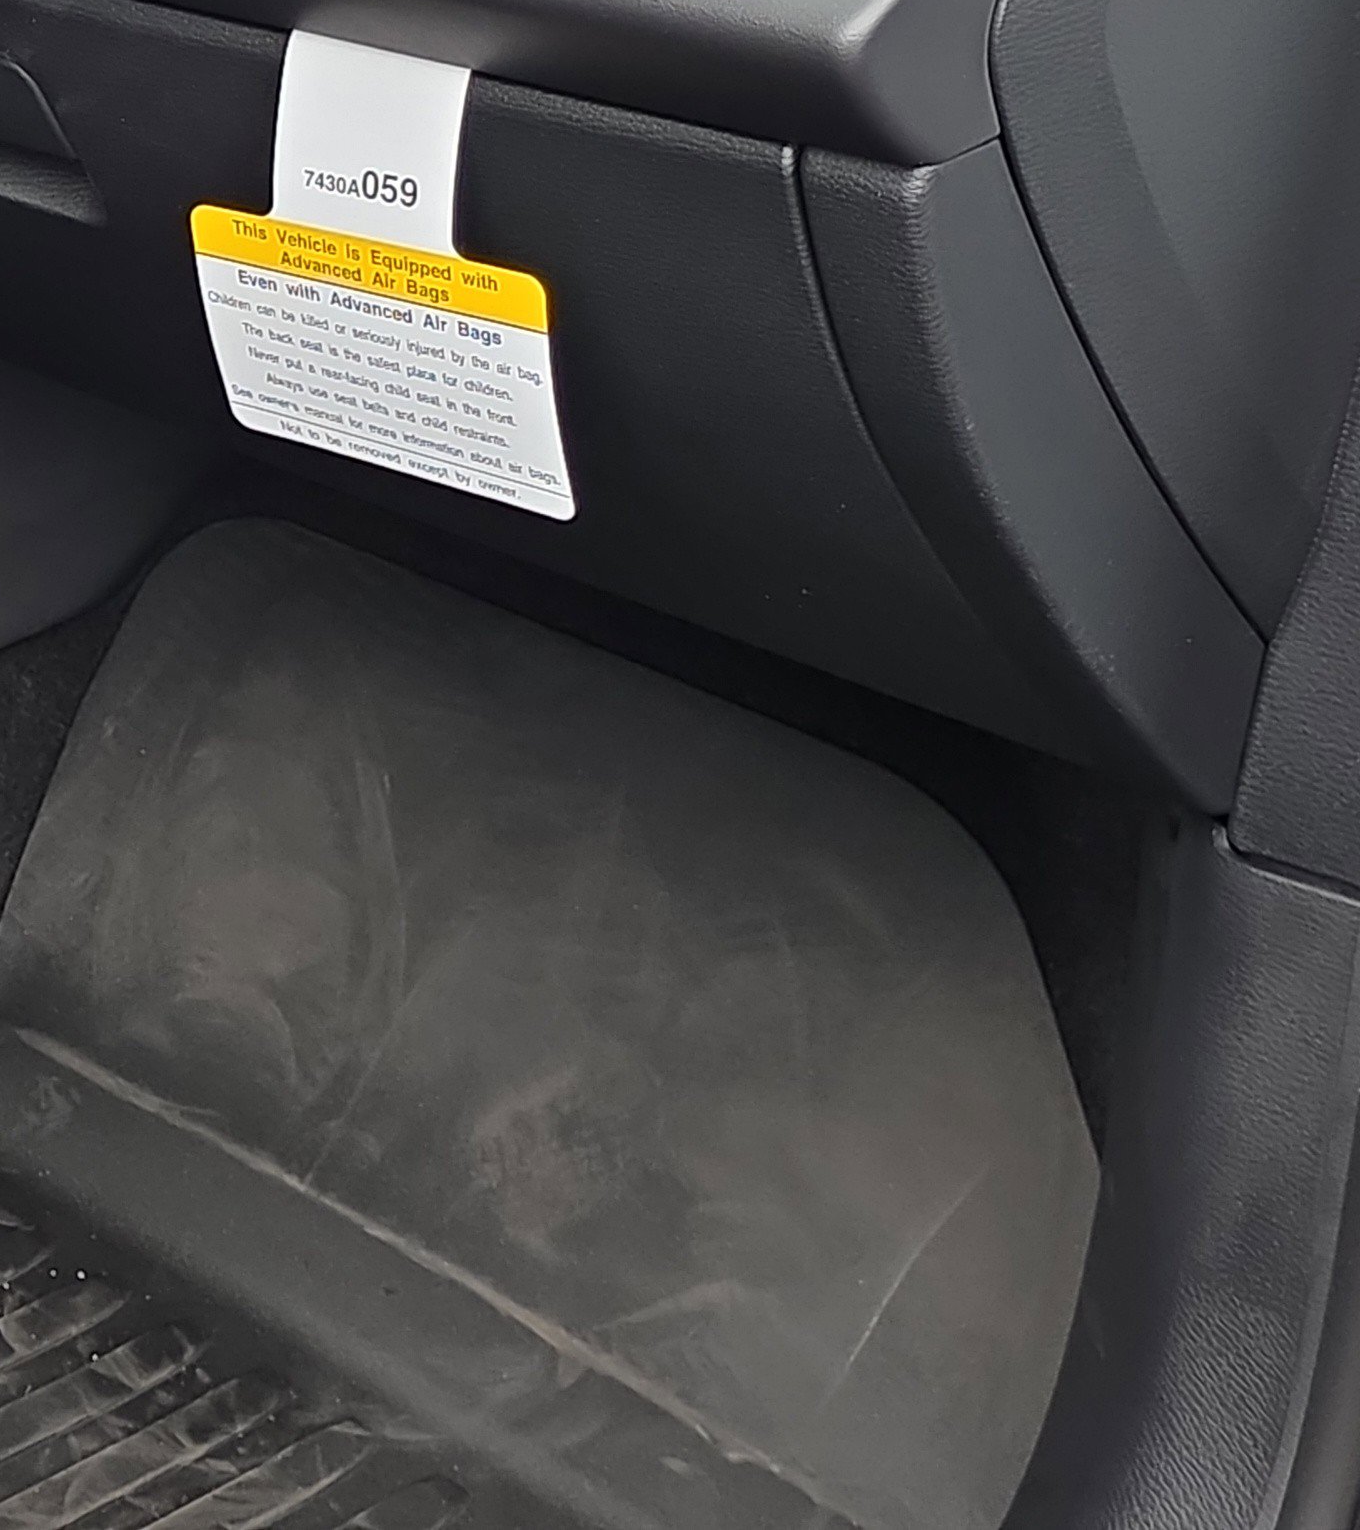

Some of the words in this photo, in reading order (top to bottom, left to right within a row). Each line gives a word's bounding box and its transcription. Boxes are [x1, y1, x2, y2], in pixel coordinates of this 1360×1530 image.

[304, 169, 418, 208] 7430A059
[232, 219, 267, 240] This
[276, 228, 337, 255] Vehicle
[346, 243, 360, 261] is
[370, 249, 451, 281] Equipped
[461, 271, 498, 292] with
[280, 251, 362, 282] Advanced
[372, 272, 396, 290] Air
[406, 280, 450, 304] Bags
[207, 290, 251, 311] Children
[256, 304, 276, 318] can
[281, 309, 295, 322] be
[300, 313, 329, 330] killed
[334, 323, 346, 334] or
[352, 328, 401, 351] seriously
[406, 339, 445, 360] injured
[450, 350, 465, 367] by
[471, 354, 490, 371] the
[496, 363, 511, 376] air
[517, 366, 543, 387] bag.
[238, 269, 277, 292] Even
[285, 283, 320, 302] with
[330, 292, 413, 324] Advanced
[423, 314, 448, 332] Air
[457, 321, 502, 346] Bags
[241, 322, 263, 338] The
[268, 328, 295, 346] back
[299, 338, 323, 353] seat
[328, 344, 339, 357] is
[343, 347, 361, 362] the
[367, 355, 400, 373] safest
[406, 366, 436, 382] place
[442, 372, 458, 387] for
[464, 379, 513, 402] children.
[248, 345, 279, 364] Never
[321, 367, 379, 393] rear-facing
[384, 383, 411, 399] child
[416, 392, 441, 407] seat
[446, 398, 458, 412] in
[462, 403, 481, 419] the
[266, 372, 304, 394] Always
[279, 420, 303, 436] Not
[307, 428, 320, 441] to
[348, 442, 402, 465] removed
